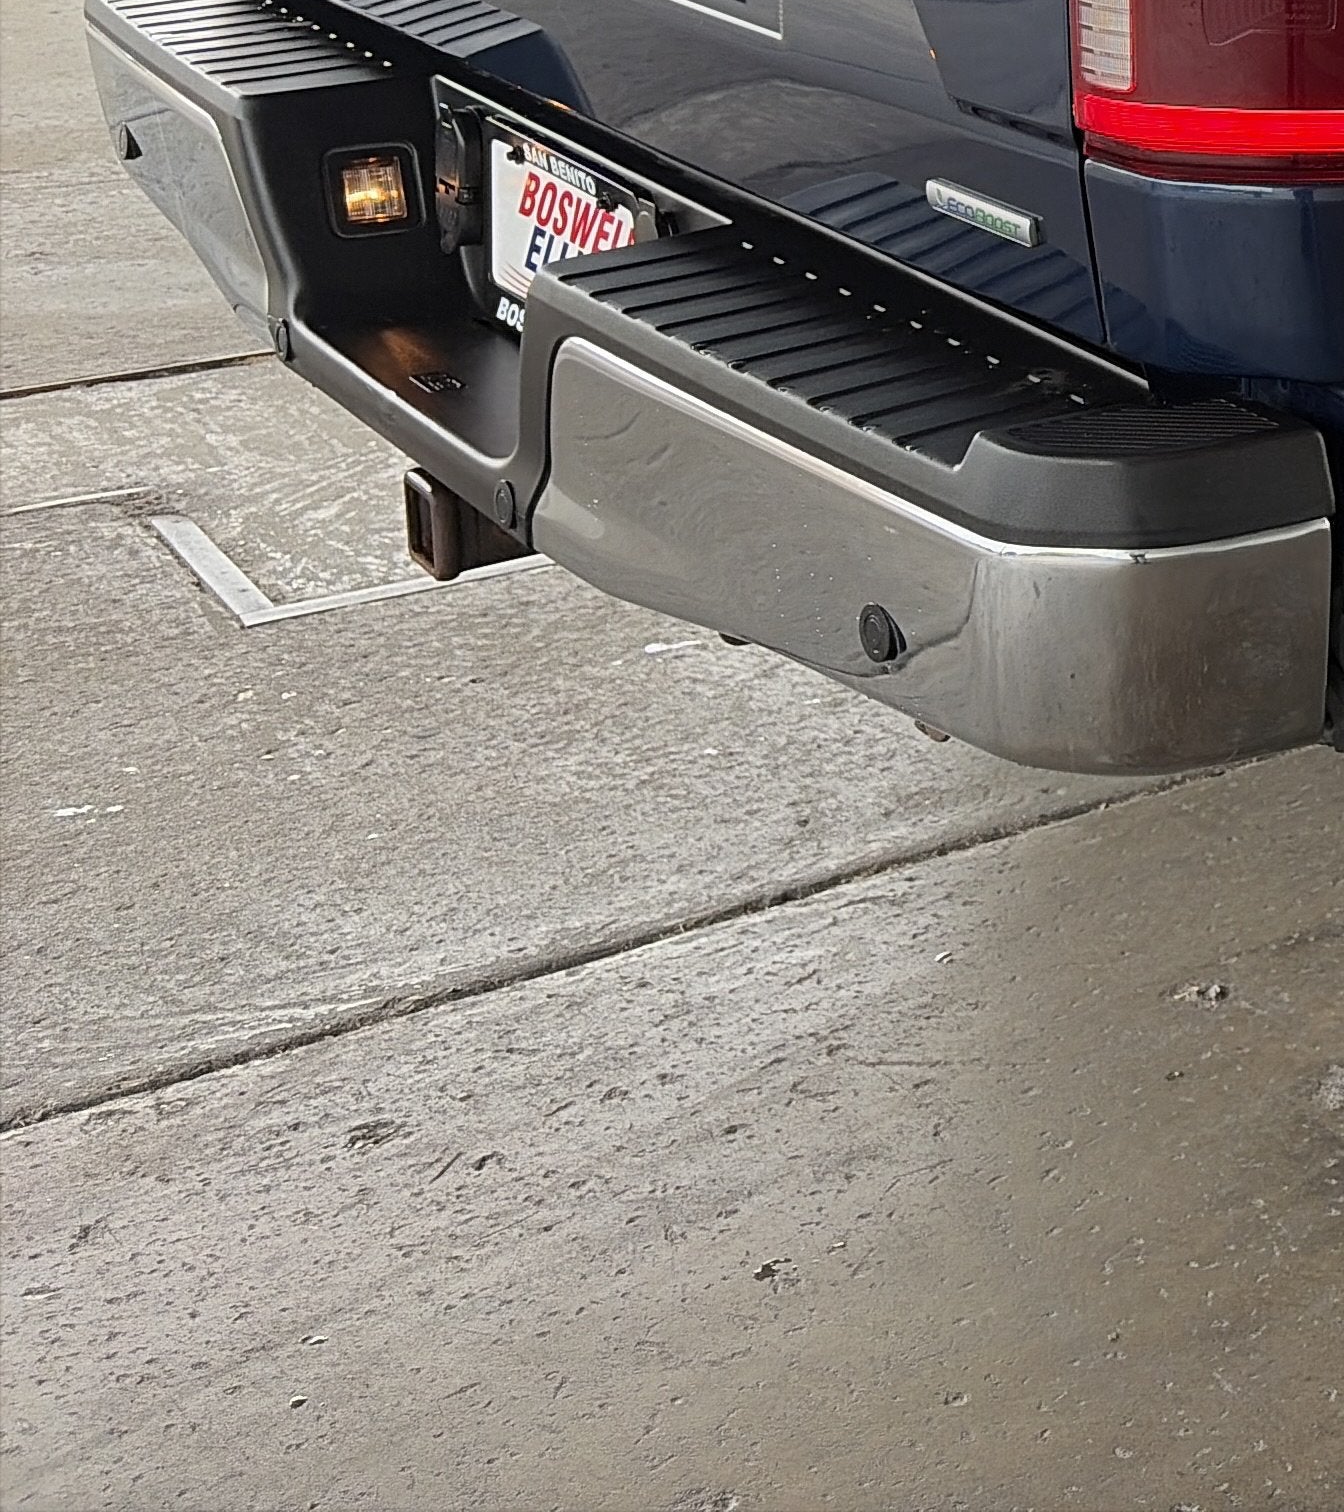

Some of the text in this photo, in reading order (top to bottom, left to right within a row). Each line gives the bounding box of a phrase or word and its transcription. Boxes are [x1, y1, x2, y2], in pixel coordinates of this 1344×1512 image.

[522, 142, 598, 196] SAN BENITO
[518, 170, 636, 256] BOSWEL
